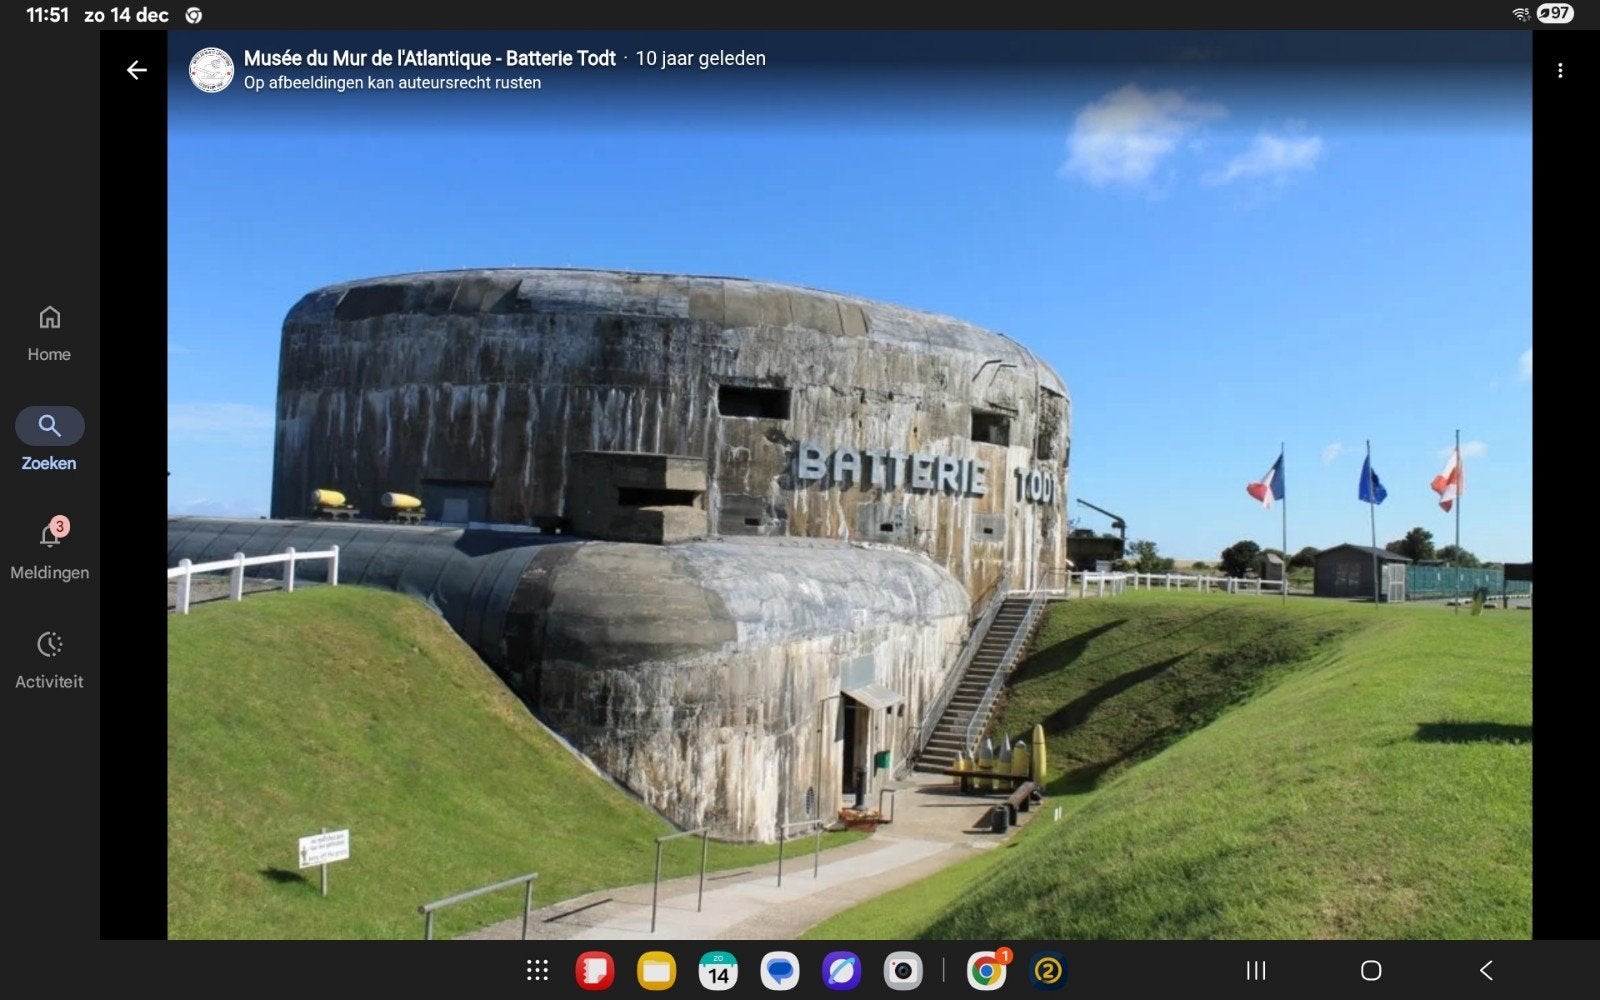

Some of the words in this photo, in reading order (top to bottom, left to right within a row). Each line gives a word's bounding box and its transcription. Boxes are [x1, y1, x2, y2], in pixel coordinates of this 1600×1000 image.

[26, 6, 69, 23] 11:51
[84, 10, 105, 23] zo
[110, 6, 131, 23] 14
[135, 6, 169, 23] dec
[1551, 6, 1569, 19] 97
[28, 347, 71, 361] Home
[21, 456, 77, 471] Zoeken
[797, 441, 990, 495] BATTERIE
[56, 520, 64, 533] 3
[10, 565, 89, 583] Meldingen
[15, 674, 83, 689] Activiteit
[1002, 951, 1008, 961] 1
[709, 968, 729, 984] 14
[1043, 963, 1054, 979] 2
